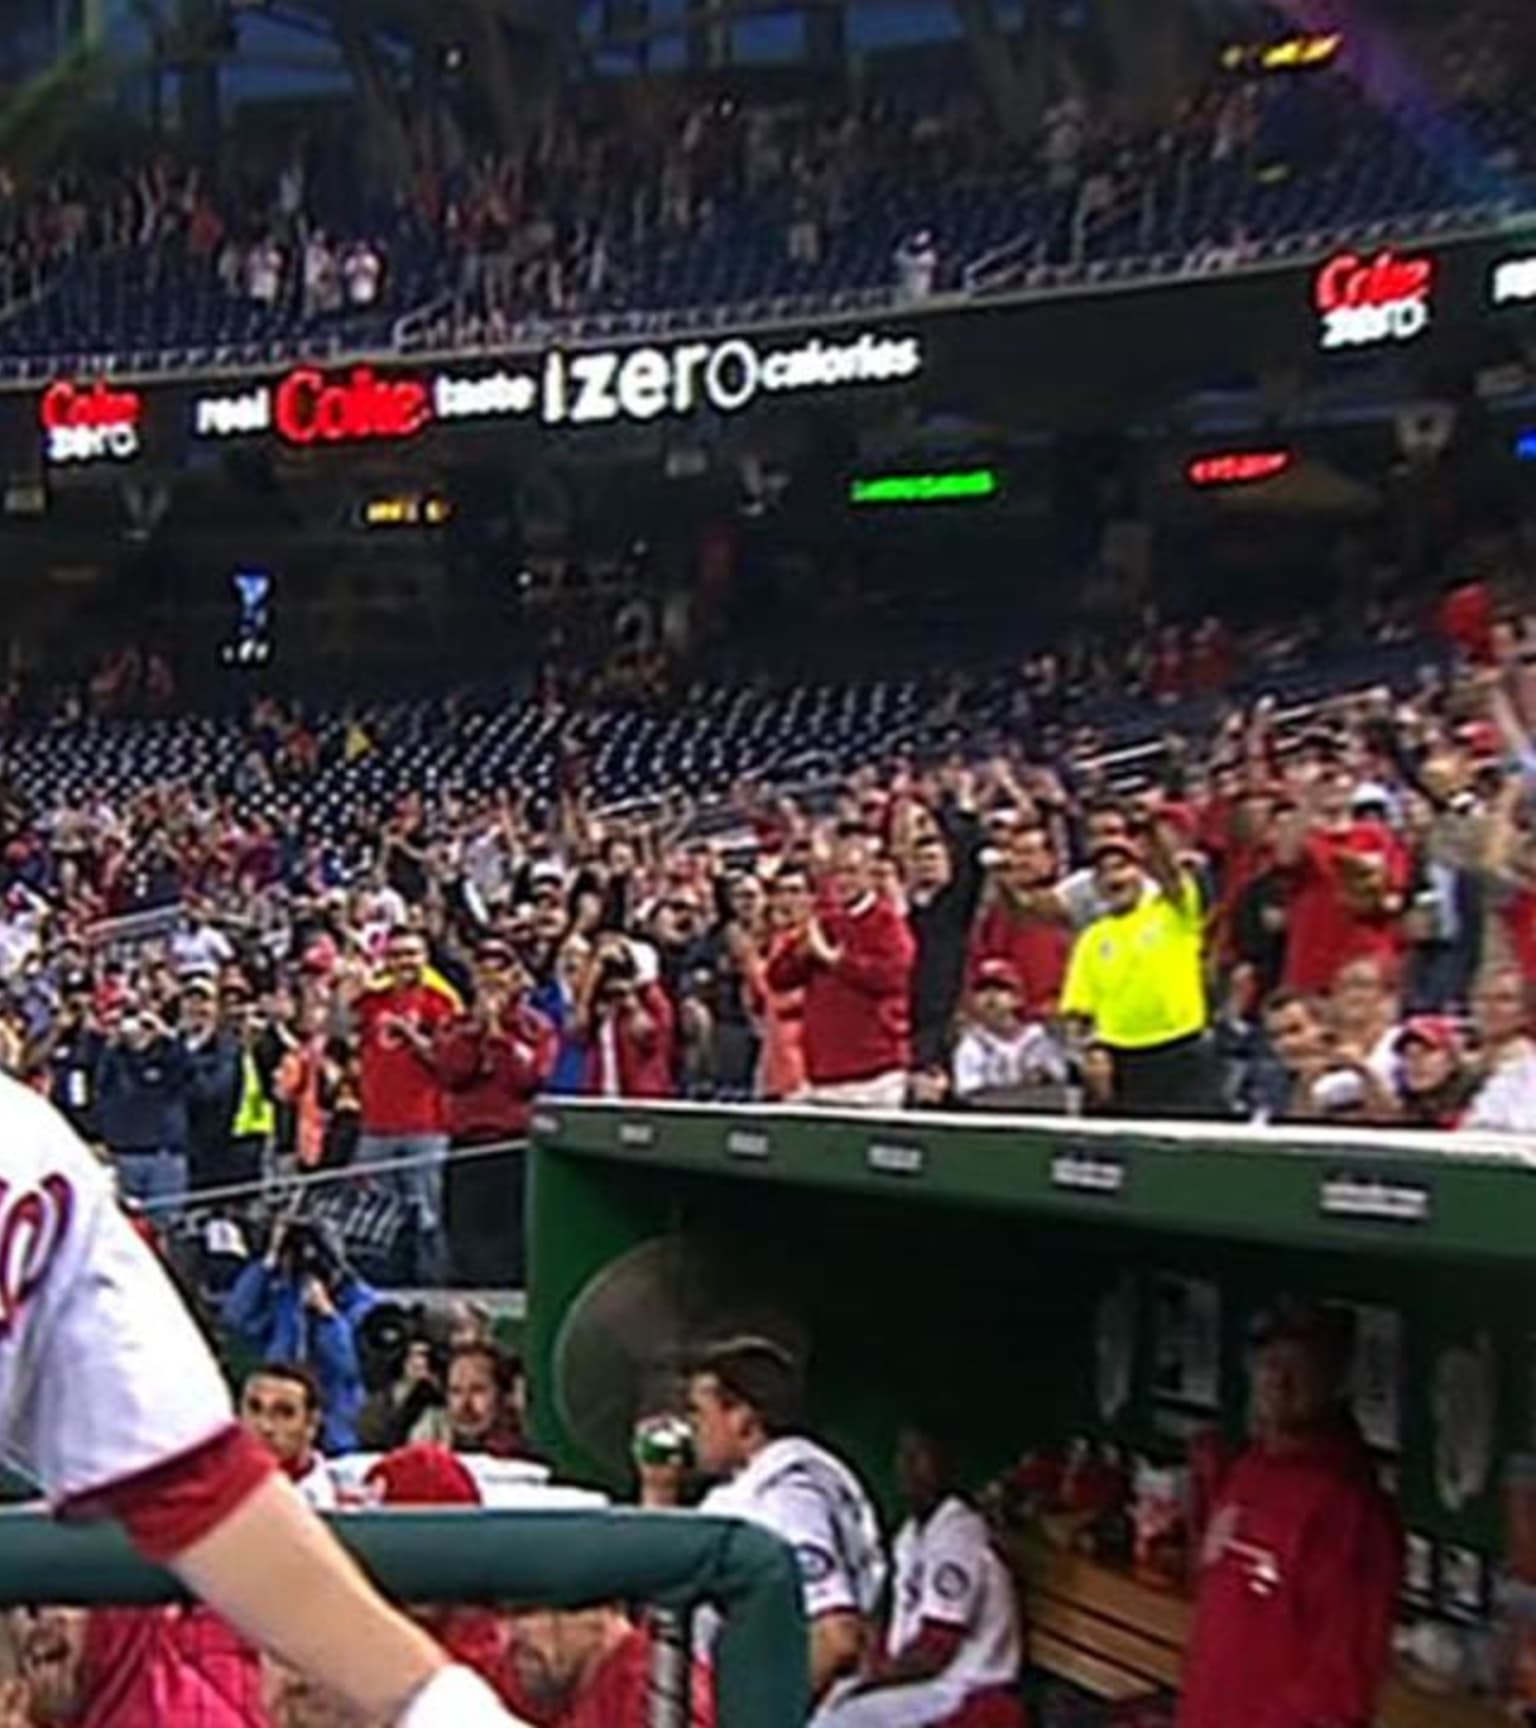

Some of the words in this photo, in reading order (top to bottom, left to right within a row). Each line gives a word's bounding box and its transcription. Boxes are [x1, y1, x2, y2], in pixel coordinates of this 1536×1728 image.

[197, 386, 270, 433] real
[277, 368, 431, 442] Coke
[434, 371, 536, 418] taste
[761, 333, 922, 390] calories
